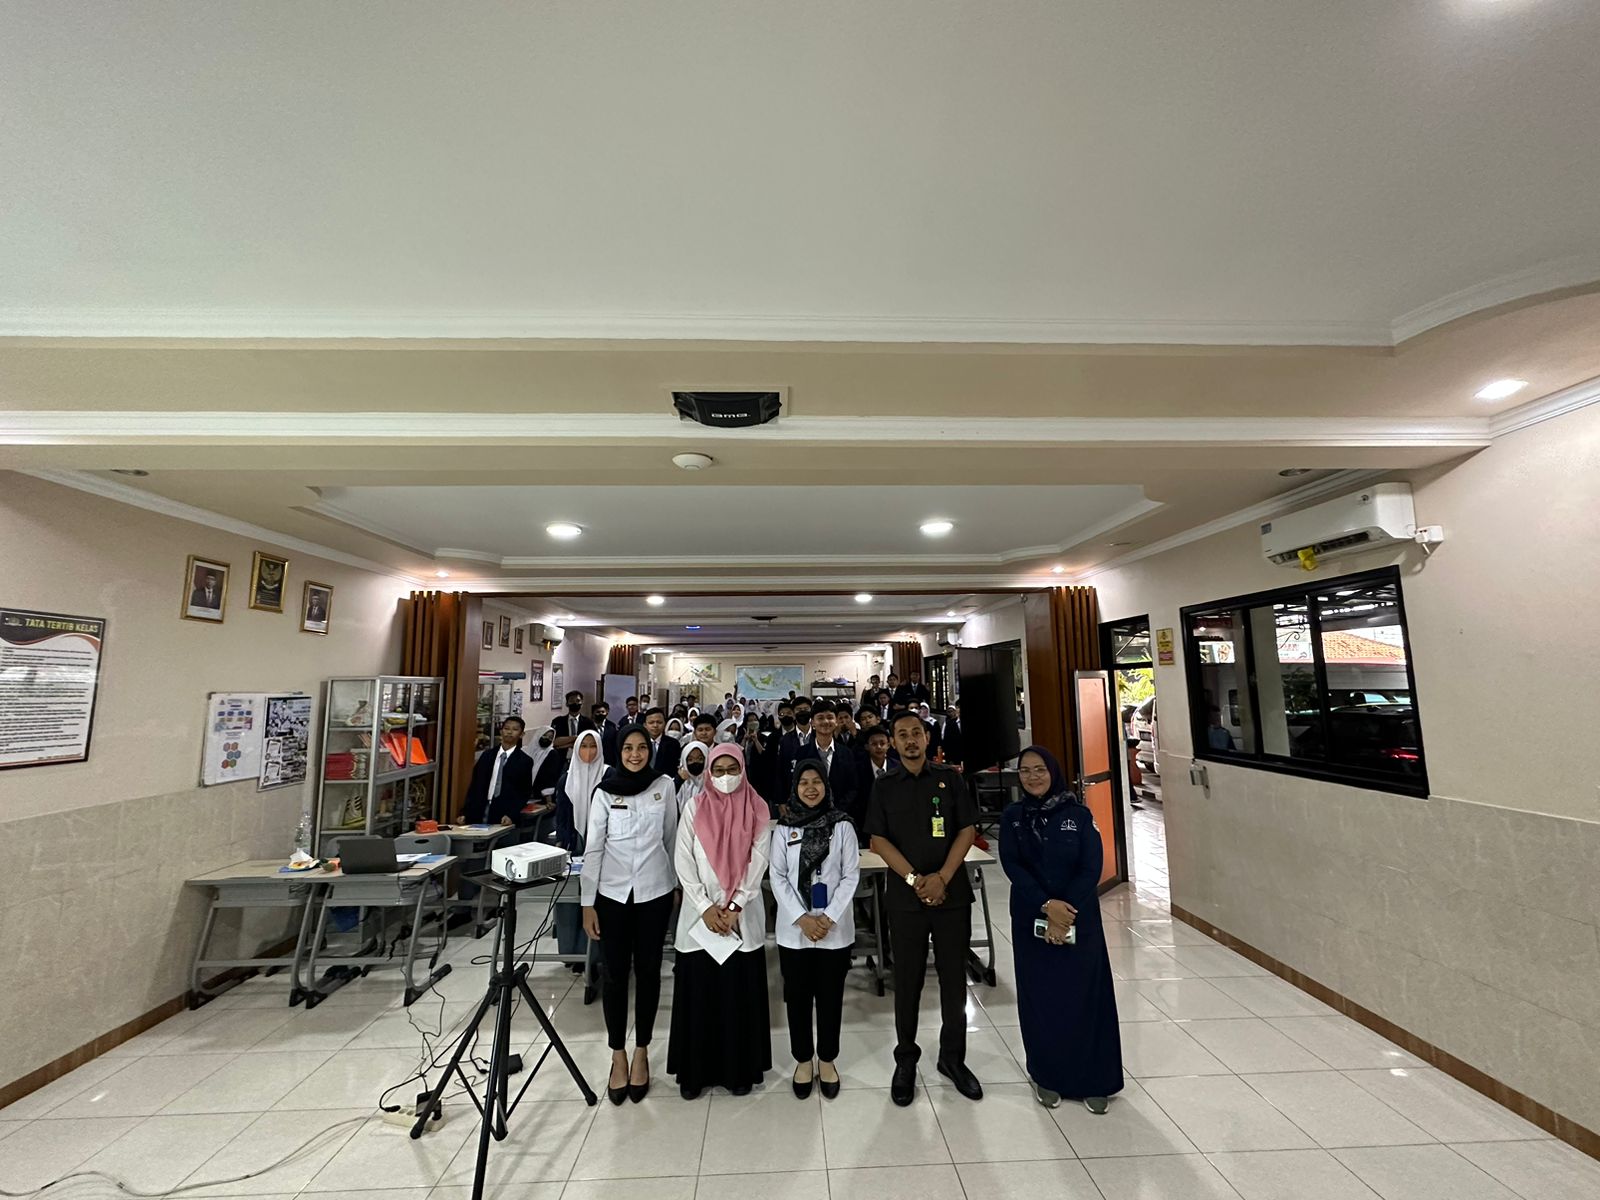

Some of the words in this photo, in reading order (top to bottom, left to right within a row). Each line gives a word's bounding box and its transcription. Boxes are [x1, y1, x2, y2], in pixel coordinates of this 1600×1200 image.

[26, 618, 45, 628] TATA
[47, 620, 74, 630] TERTIB
[75, 623, 98, 633] KELAS
